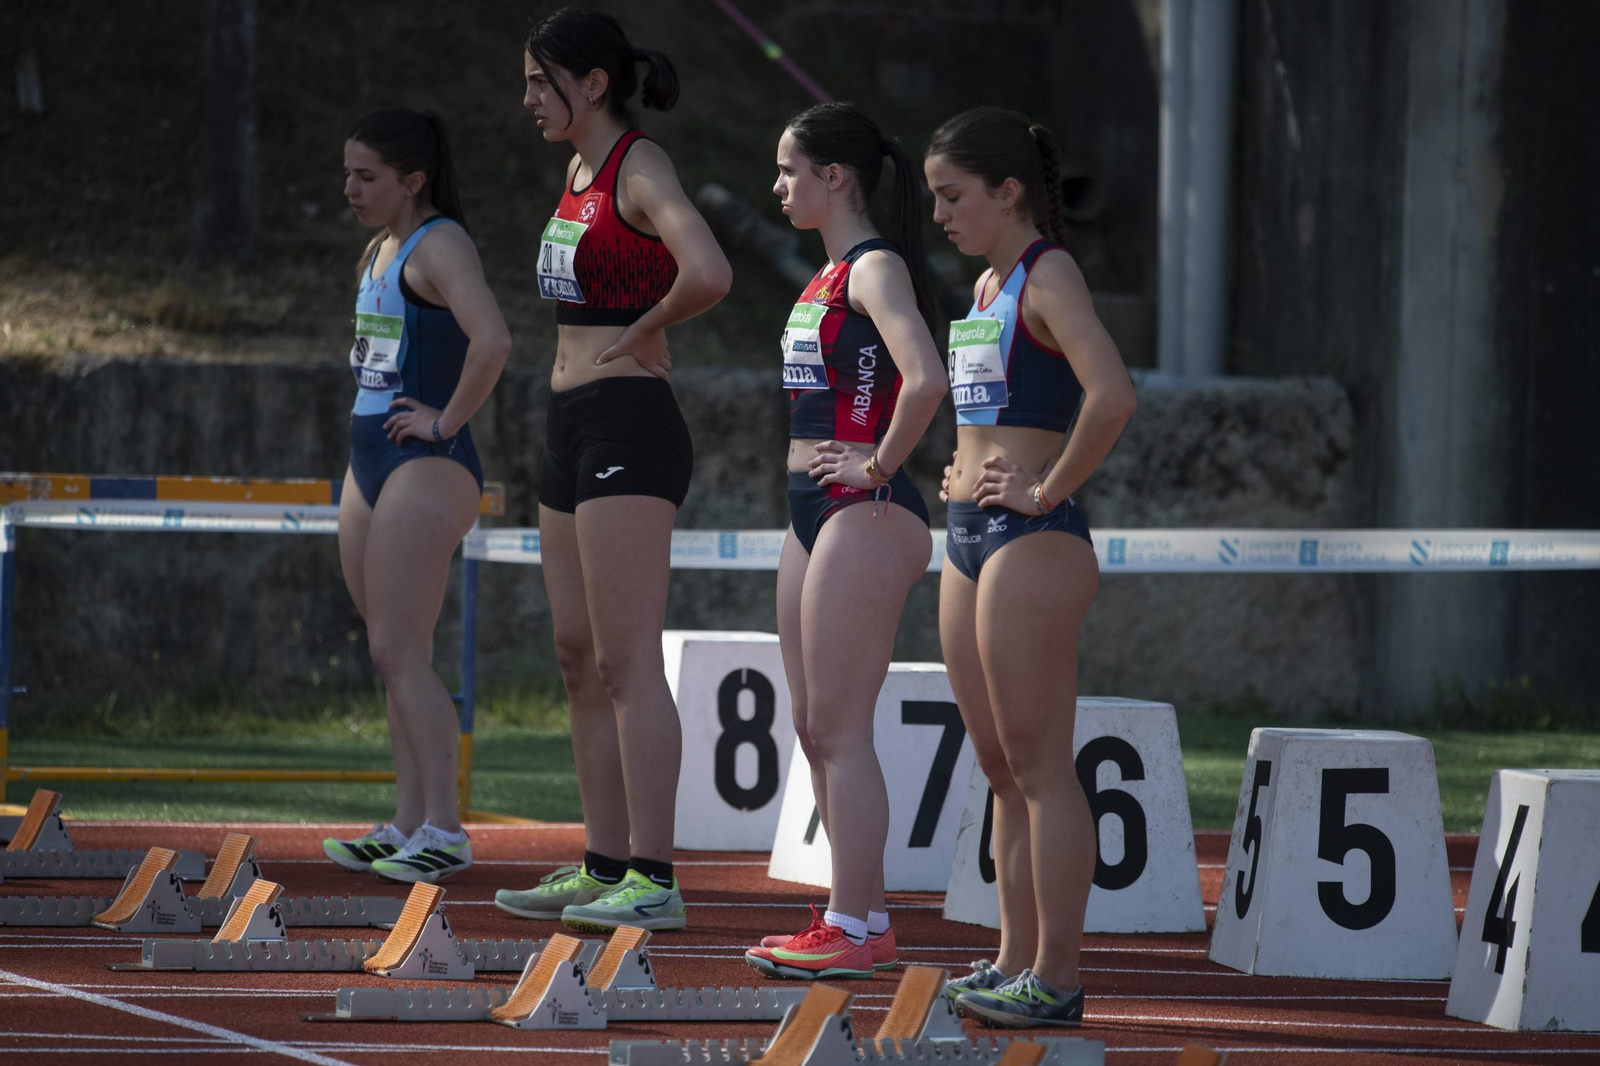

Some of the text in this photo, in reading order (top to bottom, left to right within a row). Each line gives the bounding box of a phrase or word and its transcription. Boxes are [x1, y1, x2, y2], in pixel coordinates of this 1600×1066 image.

[542, 242, 553, 274] 20
[360, 369, 389, 389] ma
[783, 365, 817, 383] ma
[952, 385, 991, 406] oma
[714, 668, 779, 811] 8
[901, 700, 967, 848] 7
[1075, 736, 1147, 890] 6
[1235, 760, 1272, 920] 5
[1317, 768, 1396, 930] 5
[1482, 804, 1530, 974] 4
